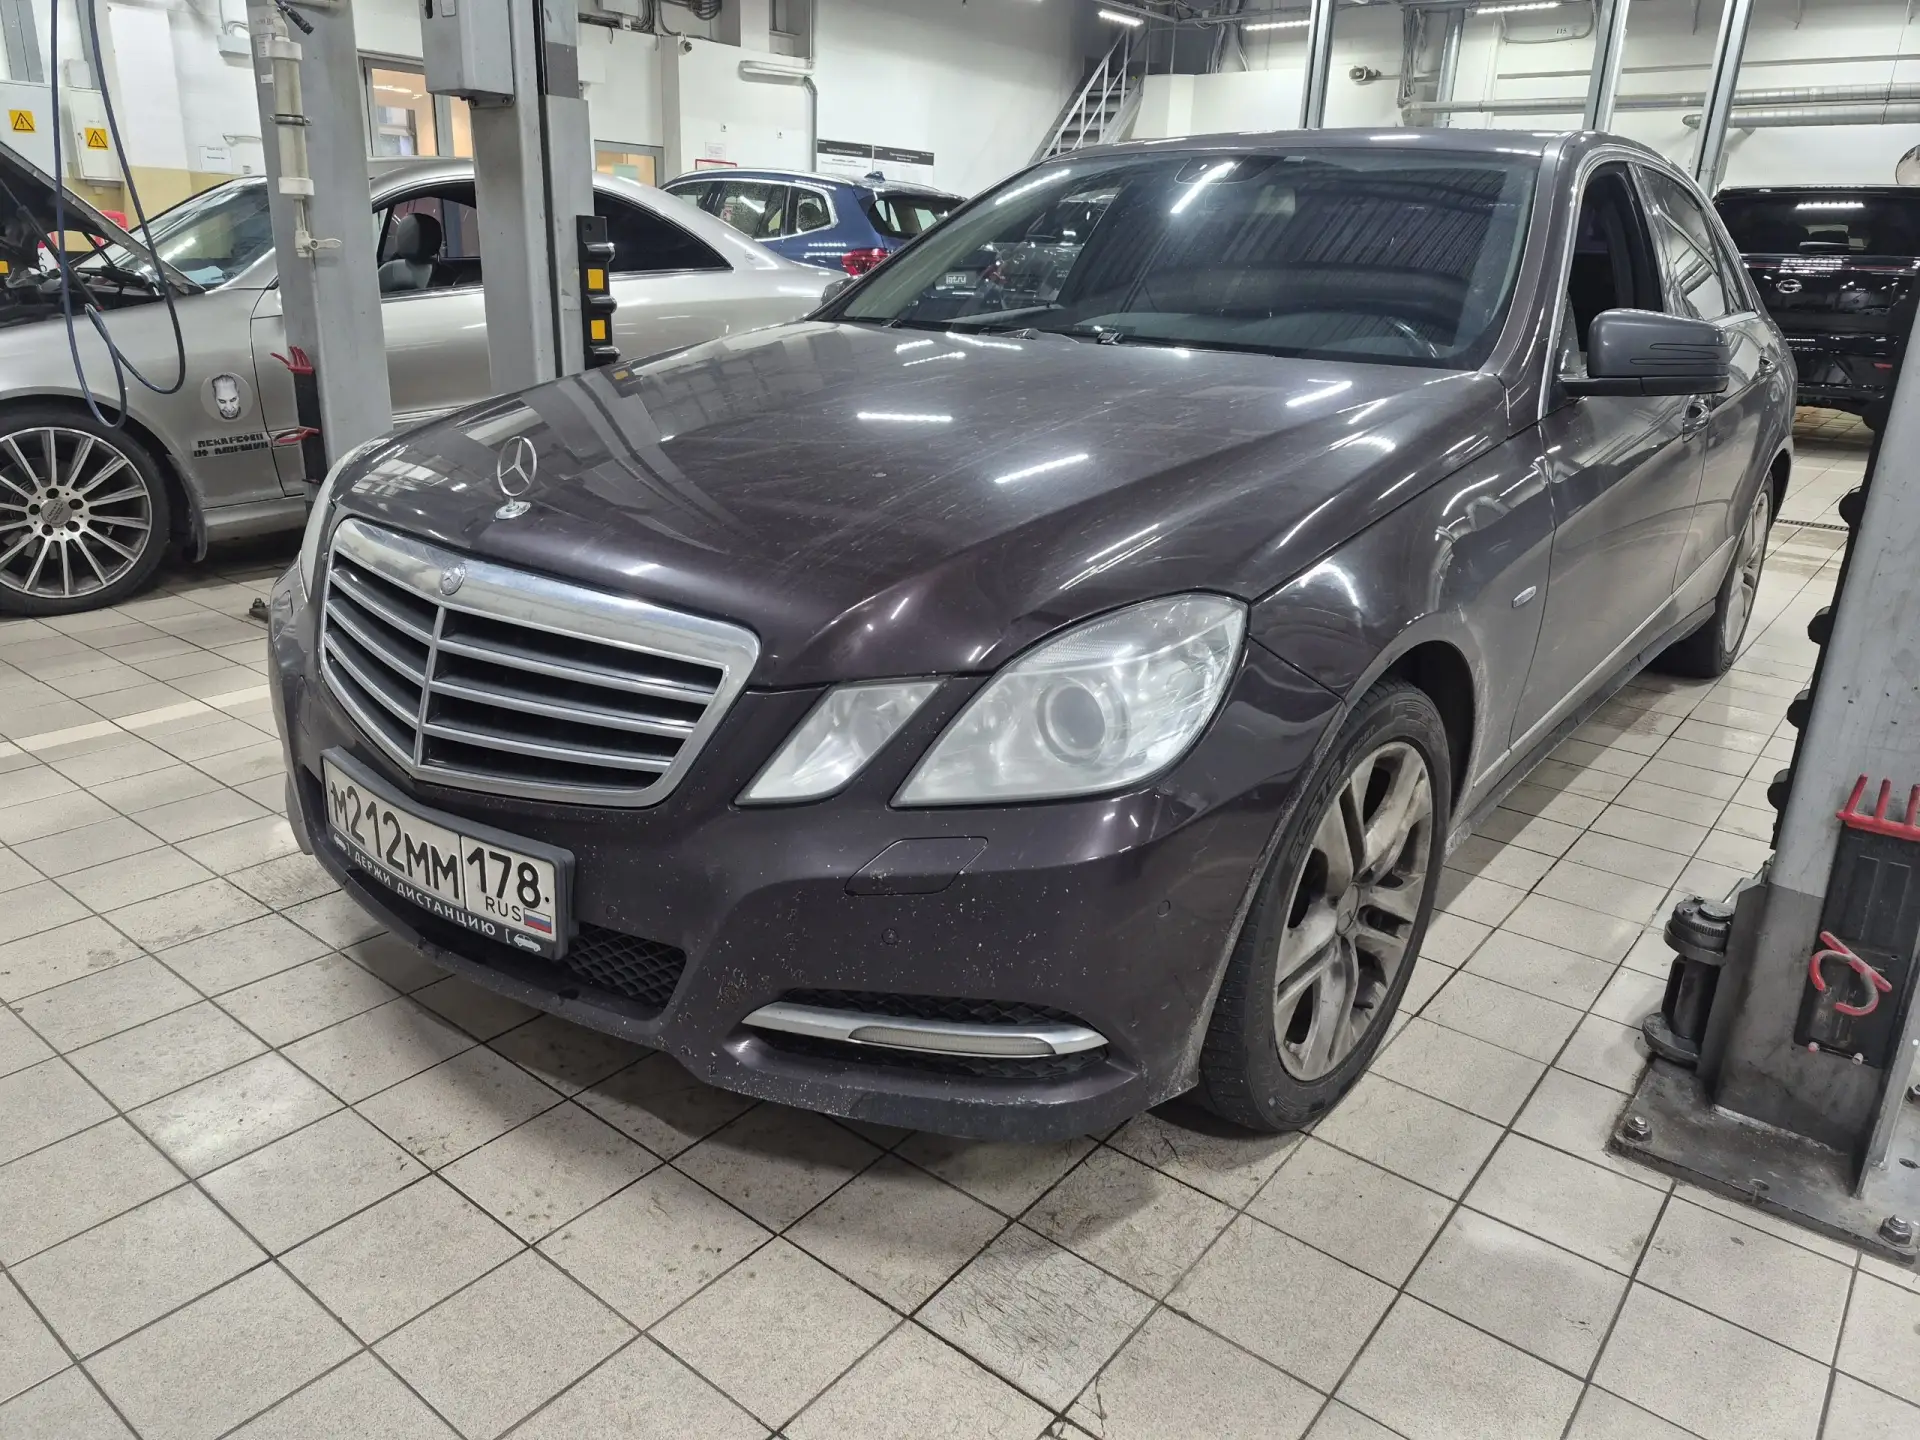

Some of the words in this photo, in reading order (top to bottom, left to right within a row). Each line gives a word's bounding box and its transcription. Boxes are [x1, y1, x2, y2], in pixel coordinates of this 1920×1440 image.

[354, 852, 391, 886] ДЕРЖИ
[396, 882, 496, 936] ДИСТАНЦИЮ
[467, 846, 541, 909] 178
[485, 896, 522, 922] RUS
